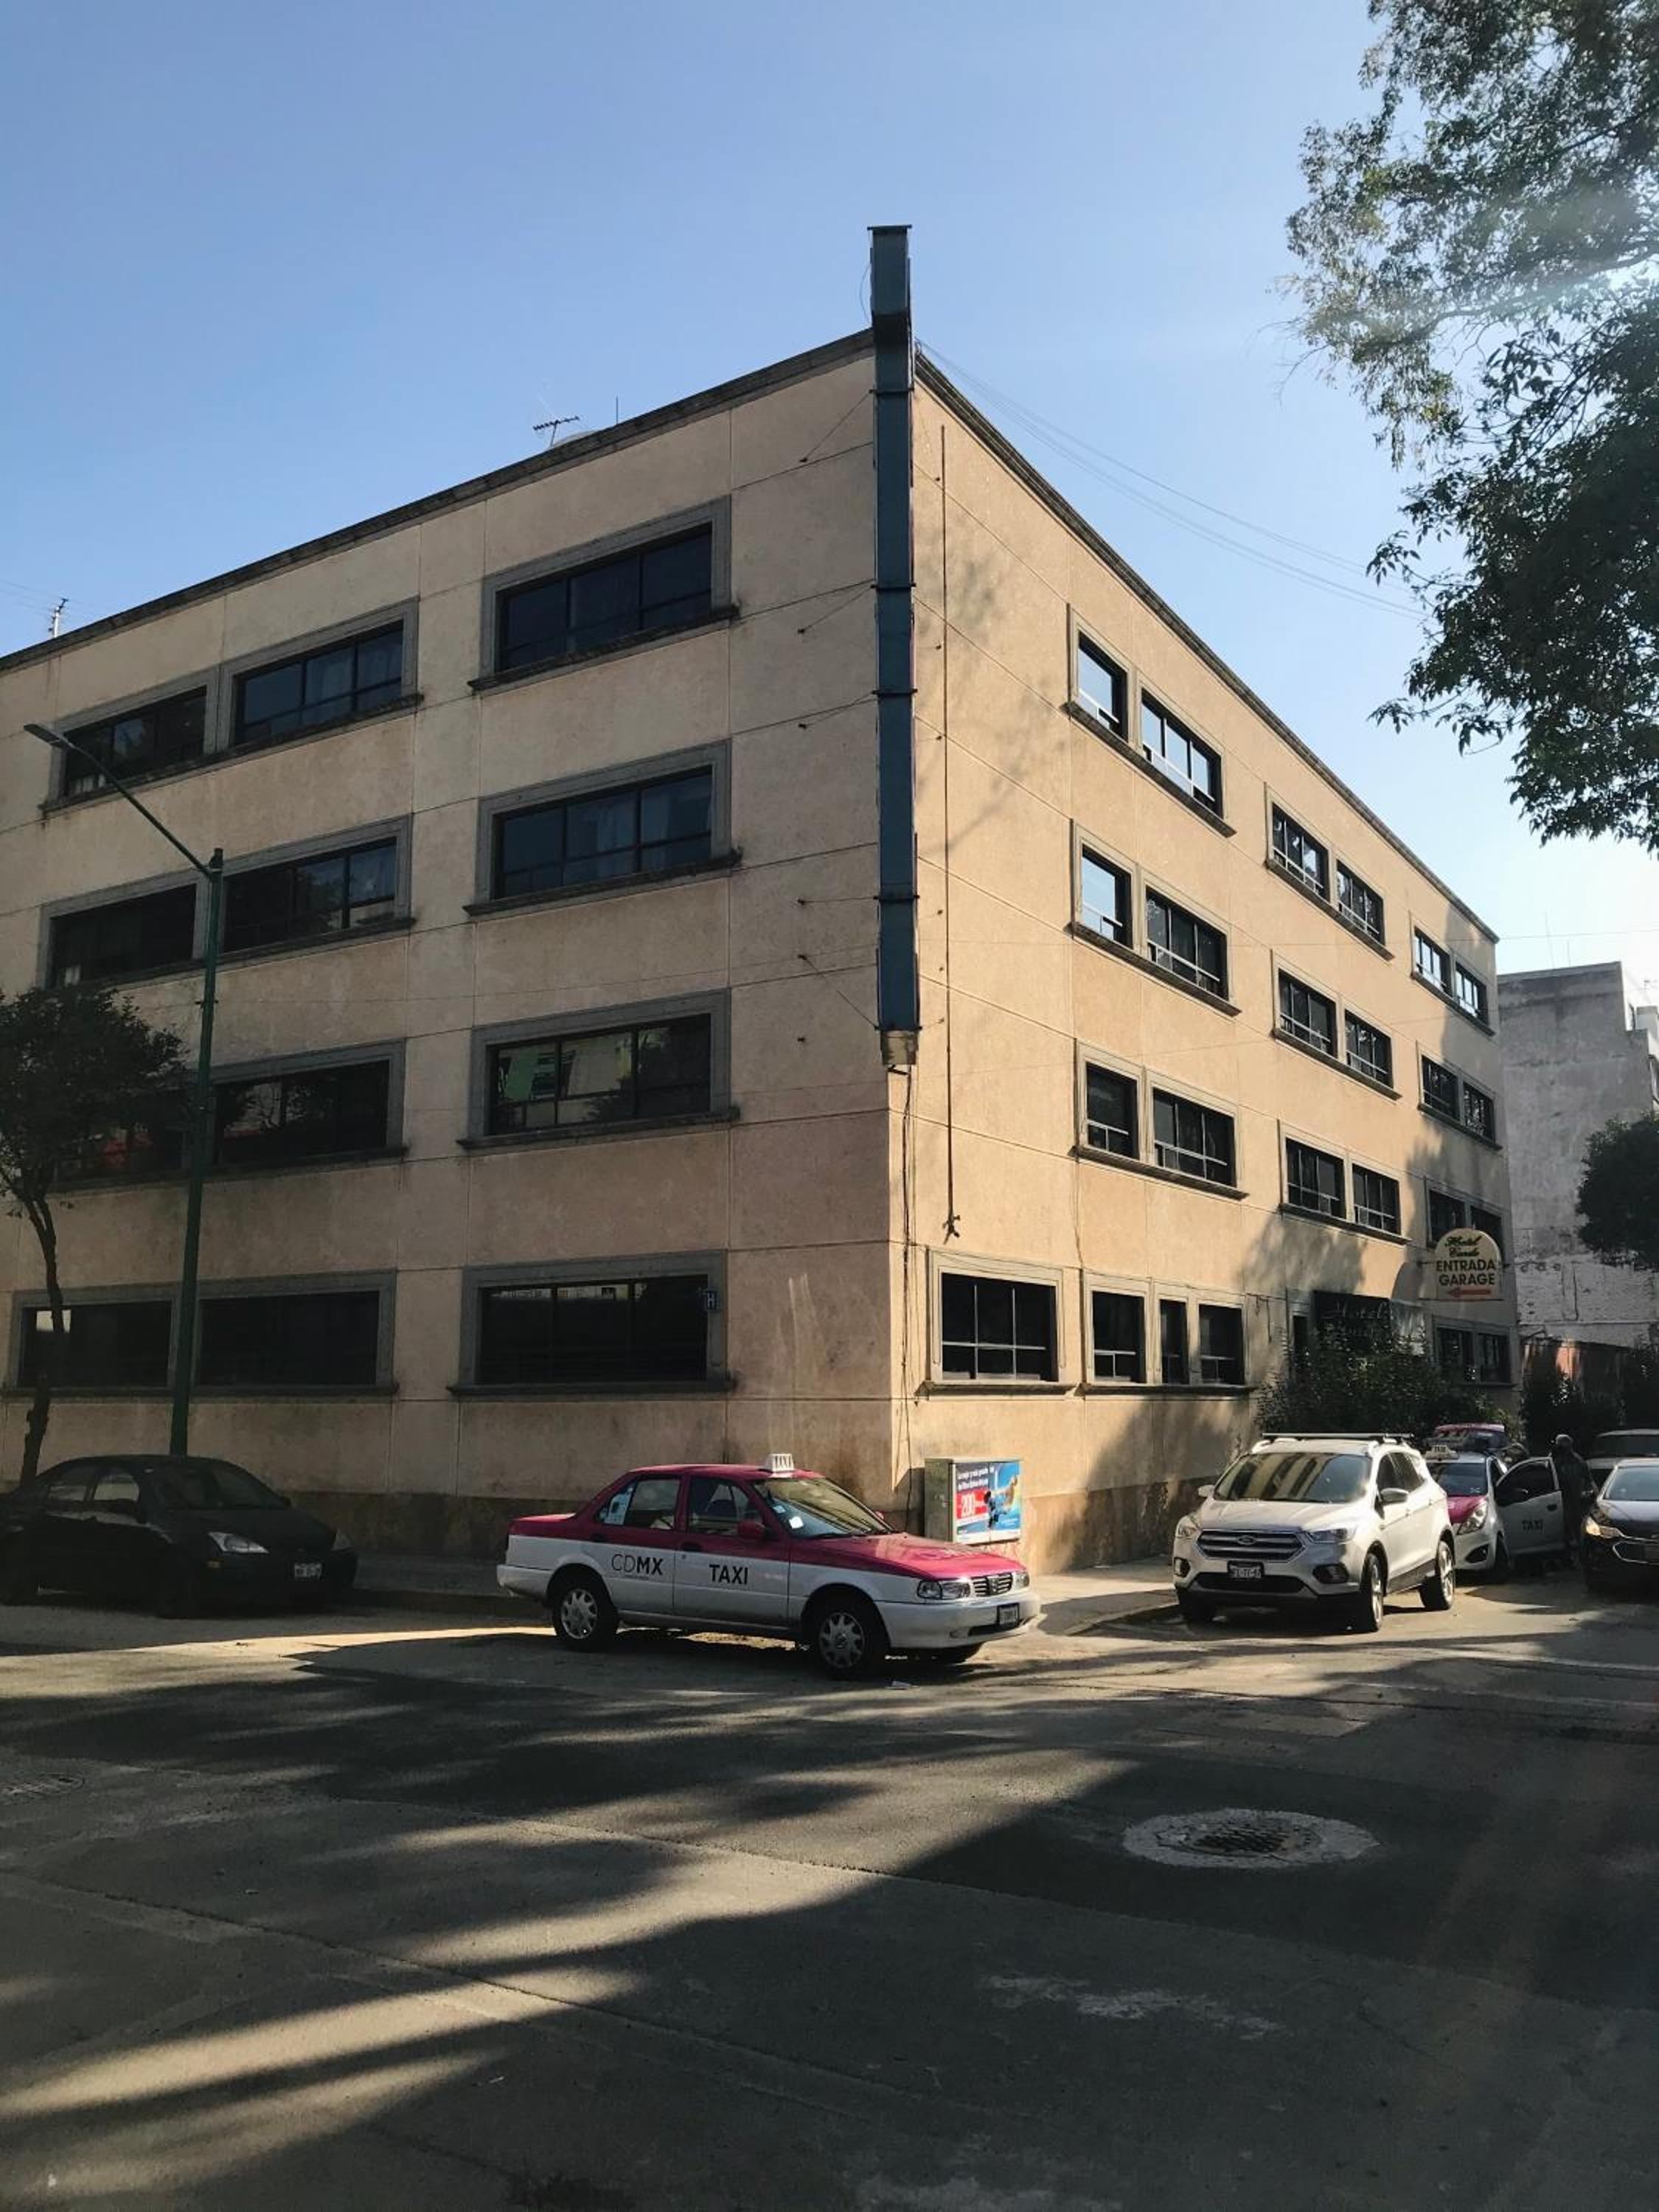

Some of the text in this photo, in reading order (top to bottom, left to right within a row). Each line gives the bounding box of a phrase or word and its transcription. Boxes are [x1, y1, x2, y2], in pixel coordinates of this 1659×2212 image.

[1436, 1259, 1497, 1272] ENTRADA
[1439, 1273, 1495, 1286] GARAGE
[1522, 1520, 1543, 1533] TAXI
[611, 1554, 664, 1576] CDMX
[709, 1564, 749, 1585] TAXI
